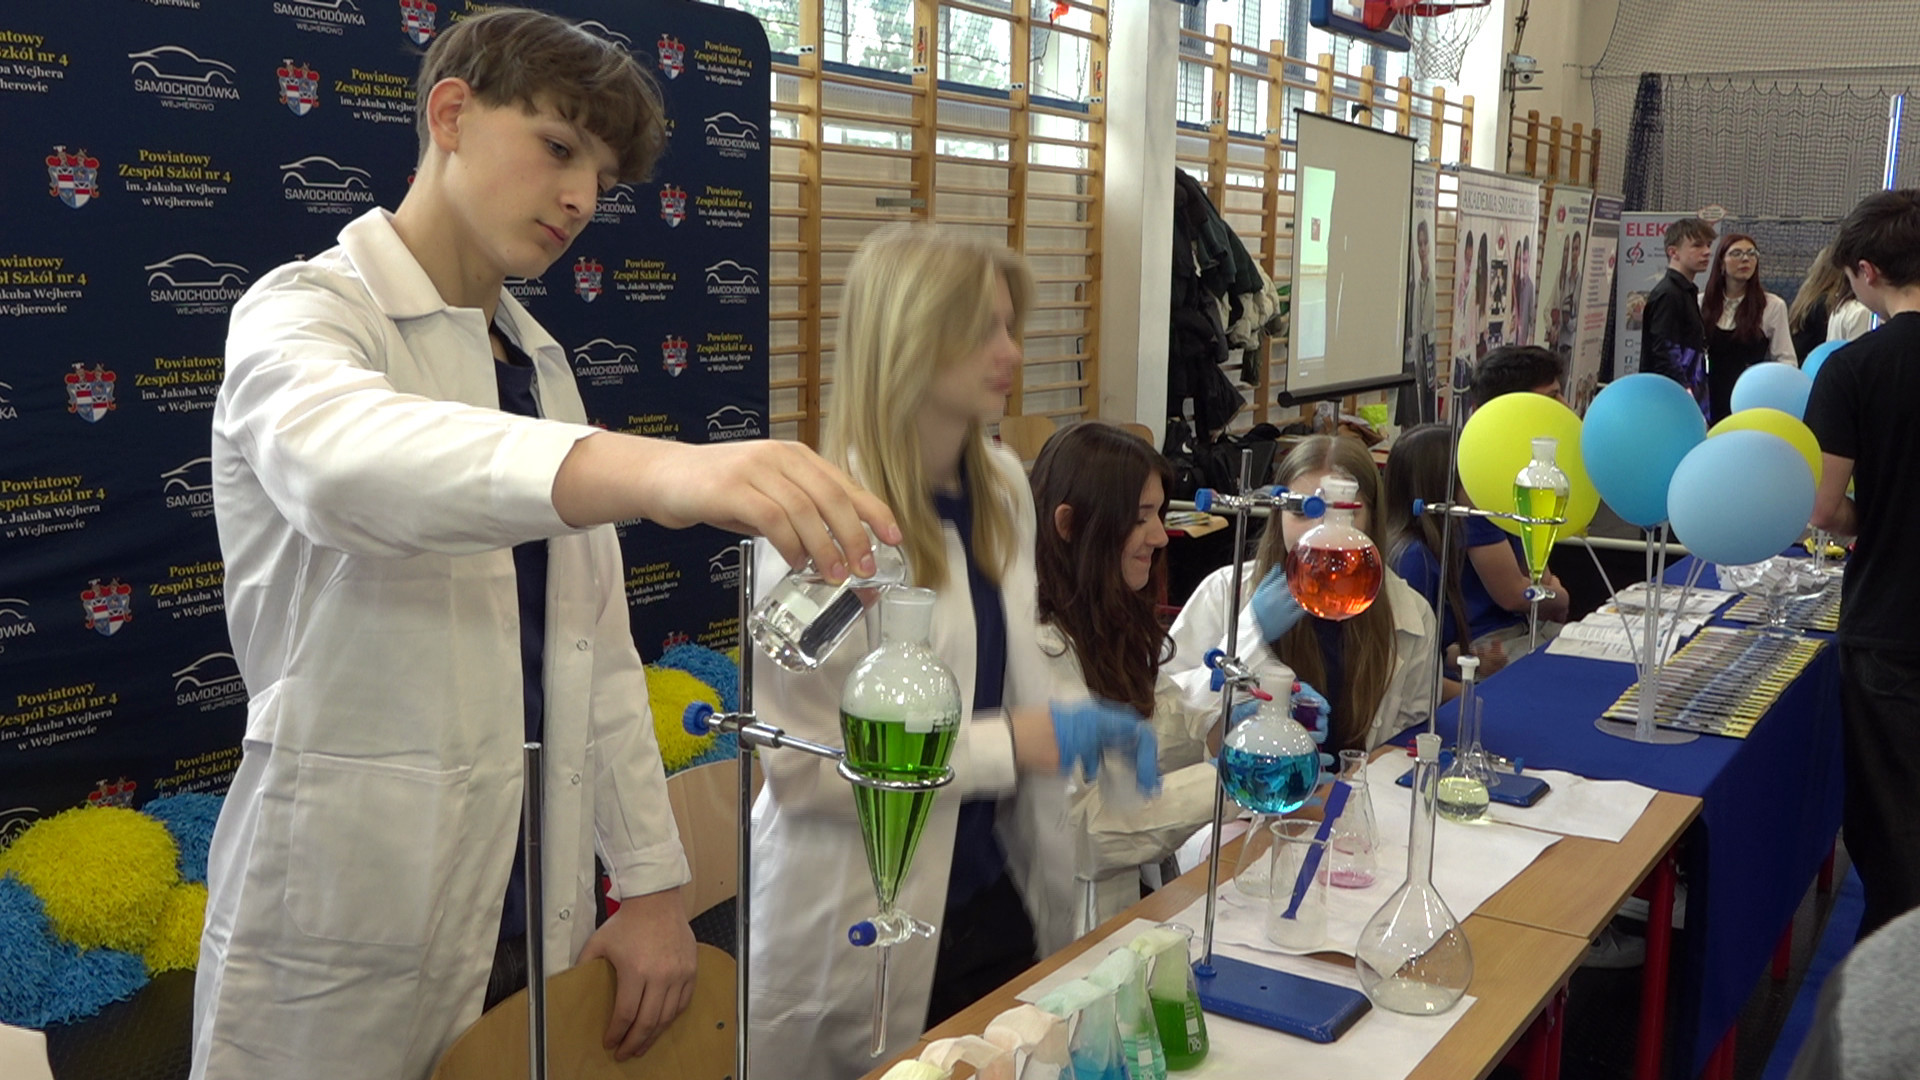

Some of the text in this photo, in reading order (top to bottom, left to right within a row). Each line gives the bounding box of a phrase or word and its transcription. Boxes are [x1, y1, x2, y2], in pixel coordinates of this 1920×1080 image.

[273, 2, 366, 25] SAMOCHODÓWKA
[296, 23, 344, 35] WEJHEROWO
[58, 53, 69, 67] 4
[351, 68, 409, 87] Powiatowy
[134, 79, 240, 100] SAMOCHODÓWKA
[160, 100, 215, 111] WEJHEROWO
[362, 111, 411, 123] Wejherowie
[706, 136, 760, 150] SAMOCHODÓWKA
[139, 149, 211, 167] Powiatowy
[204, 170, 220, 180] nr
[222, 171, 232, 183] 4
[126, 181, 227, 196] im. Jakuba Wejhera
[285, 188, 375, 203] SAMOCHODÓWKA
[141, 196, 214, 209] w Wejherowie
[1462, 190, 1497, 212] AKADEMIA
[307, 205, 353, 215] WEJHEROWO
[57, 273, 74, 284] nr
[77, 273, 88, 286] 4
[33, 288, 82, 301] Wejhera
[707, 284, 760, 295] SAMOCHODÓWKA
[176, 306, 228, 315] WEJHEROWO
[154, 356, 225, 370] Powiatowy
[576, 363, 639, 377] SAMOCHODÓWKA
[142, 389, 159, 400] im.
[161, 386, 197, 399] Jakuba
[158, 404, 167, 413] w
[1, 475, 82, 493] Powiatowy
[76, 489, 93, 500] nr
[96, 488, 105, 500] 4
[9, 509, 52, 523] Jakuba
[54, 504, 100, 518] Wejhera
[18, 519, 86, 537] Wejherowie
[157, 598, 173, 609] im.
[175, 592, 211, 605] Jakuba
[17, 682, 95, 707] Powiatowy
[89, 695, 107, 708] nr
[109, 692, 119, 704] 4
[22, 720, 64, 736] Jakuba
[66, 709, 113, 725] Wejhera
[18, 725, 97, 751] w Wejherowie
[174, 746, 241, 771] Powiatowy
